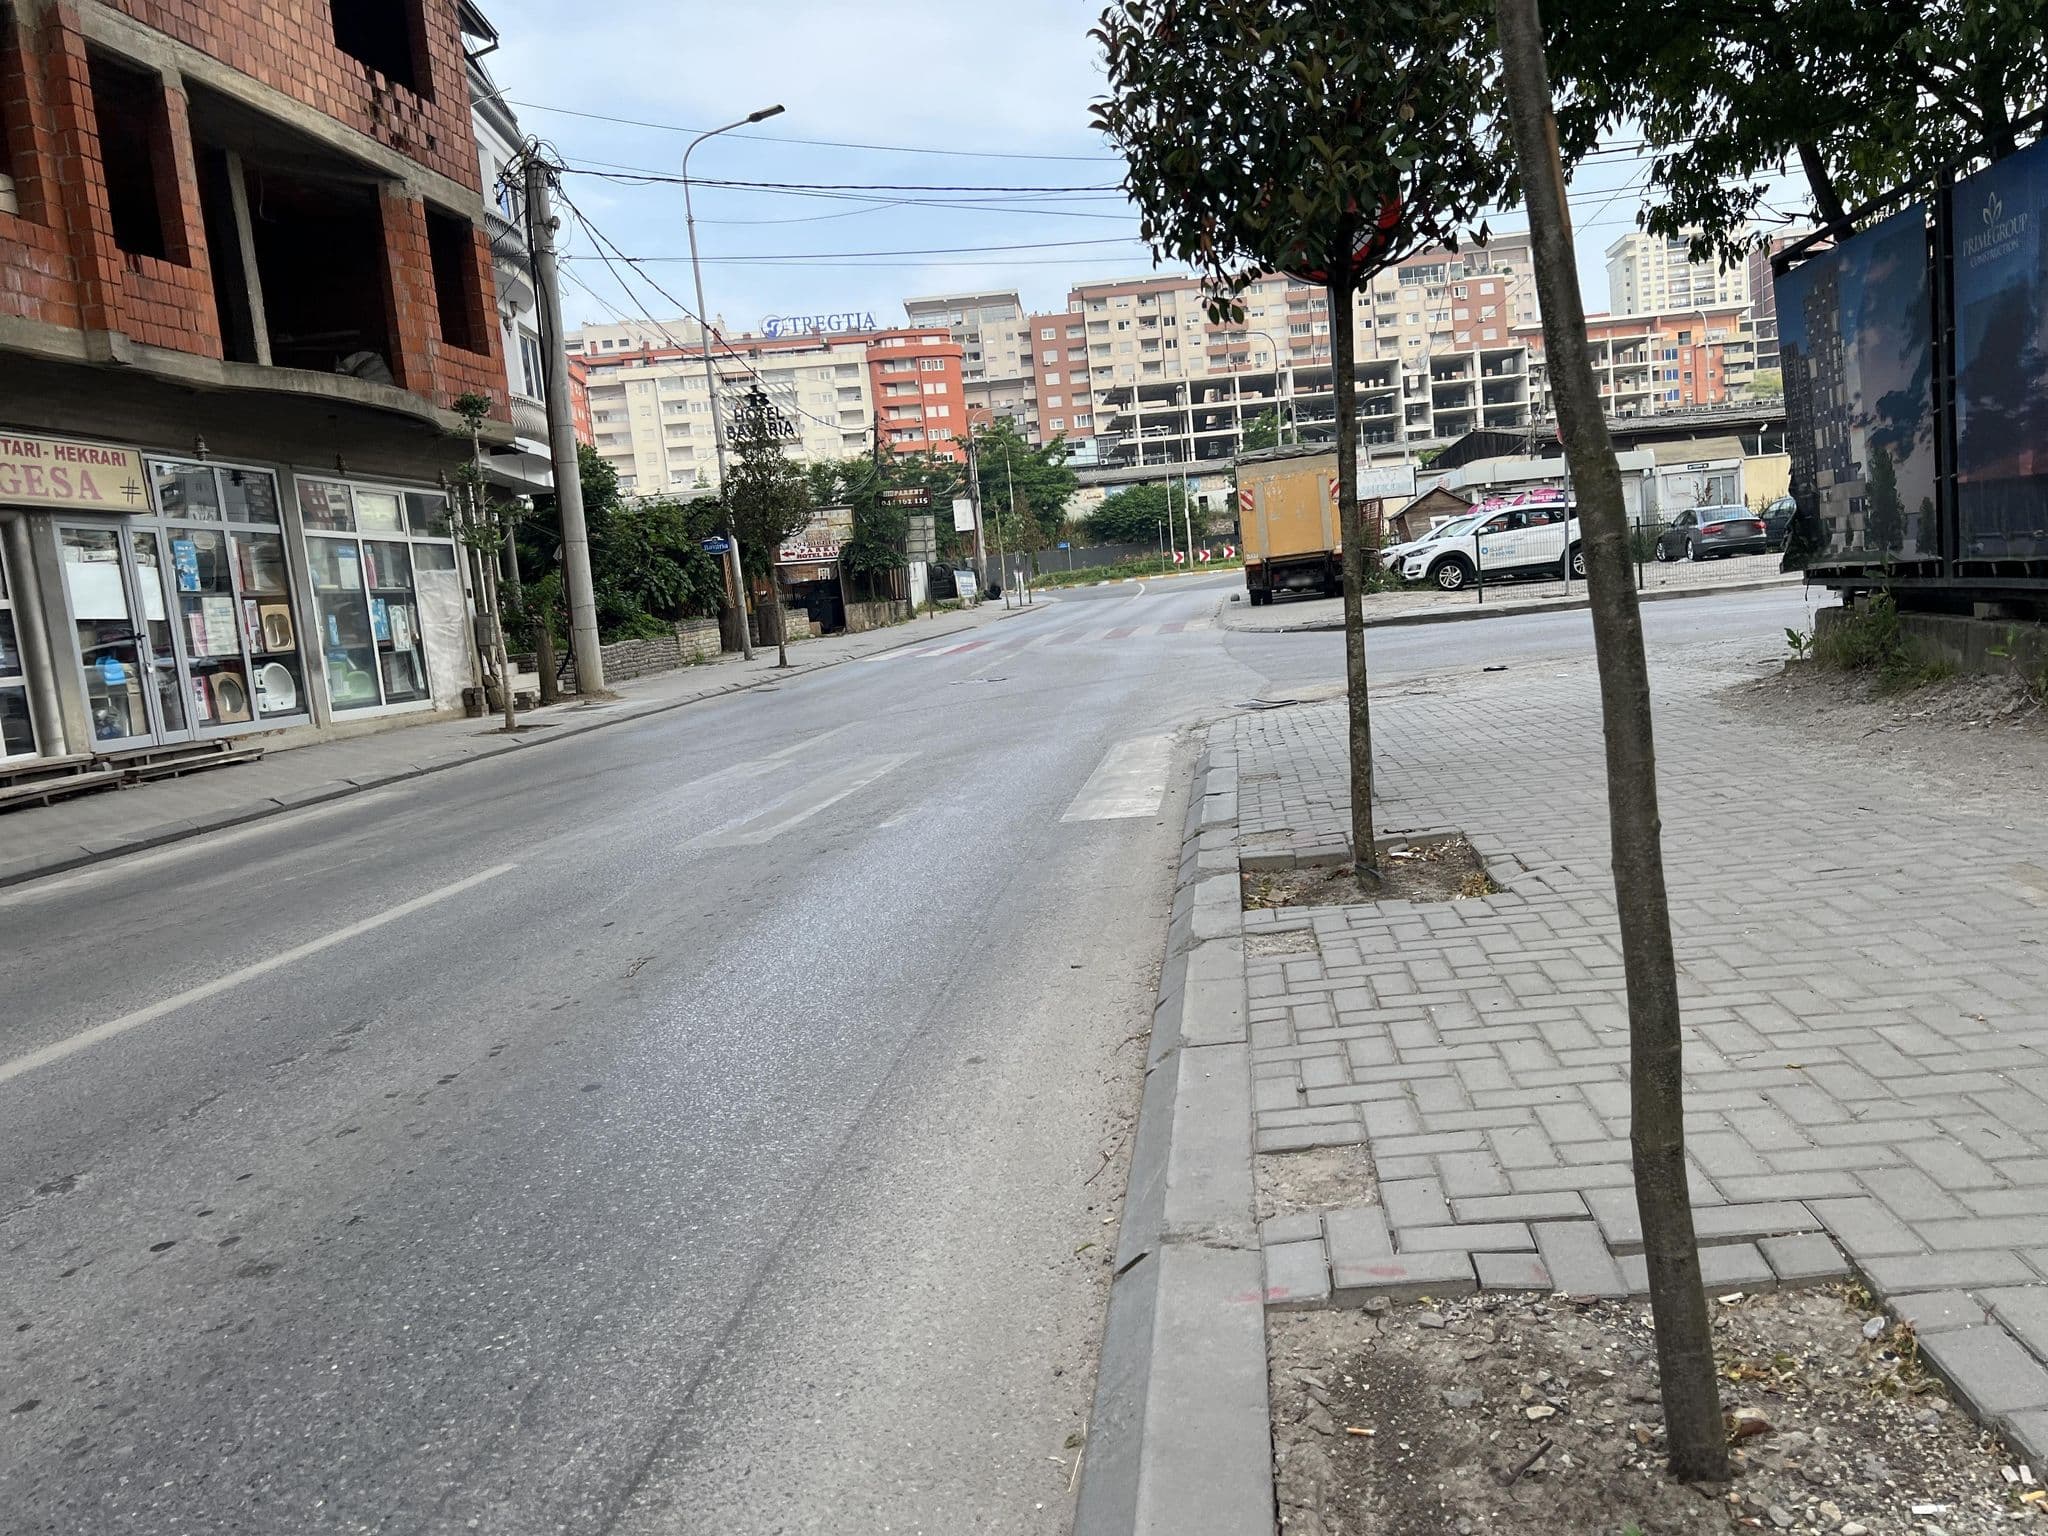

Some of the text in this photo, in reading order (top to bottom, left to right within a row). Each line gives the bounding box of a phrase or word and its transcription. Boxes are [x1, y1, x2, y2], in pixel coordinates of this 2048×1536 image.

[788, 311, 877, 334] TREGTIA
[733, 406, 785, 423] HOTEL
[726, 420, 795, 440] BAVRIA
[53, 445, 127, 467] HEKRARI
